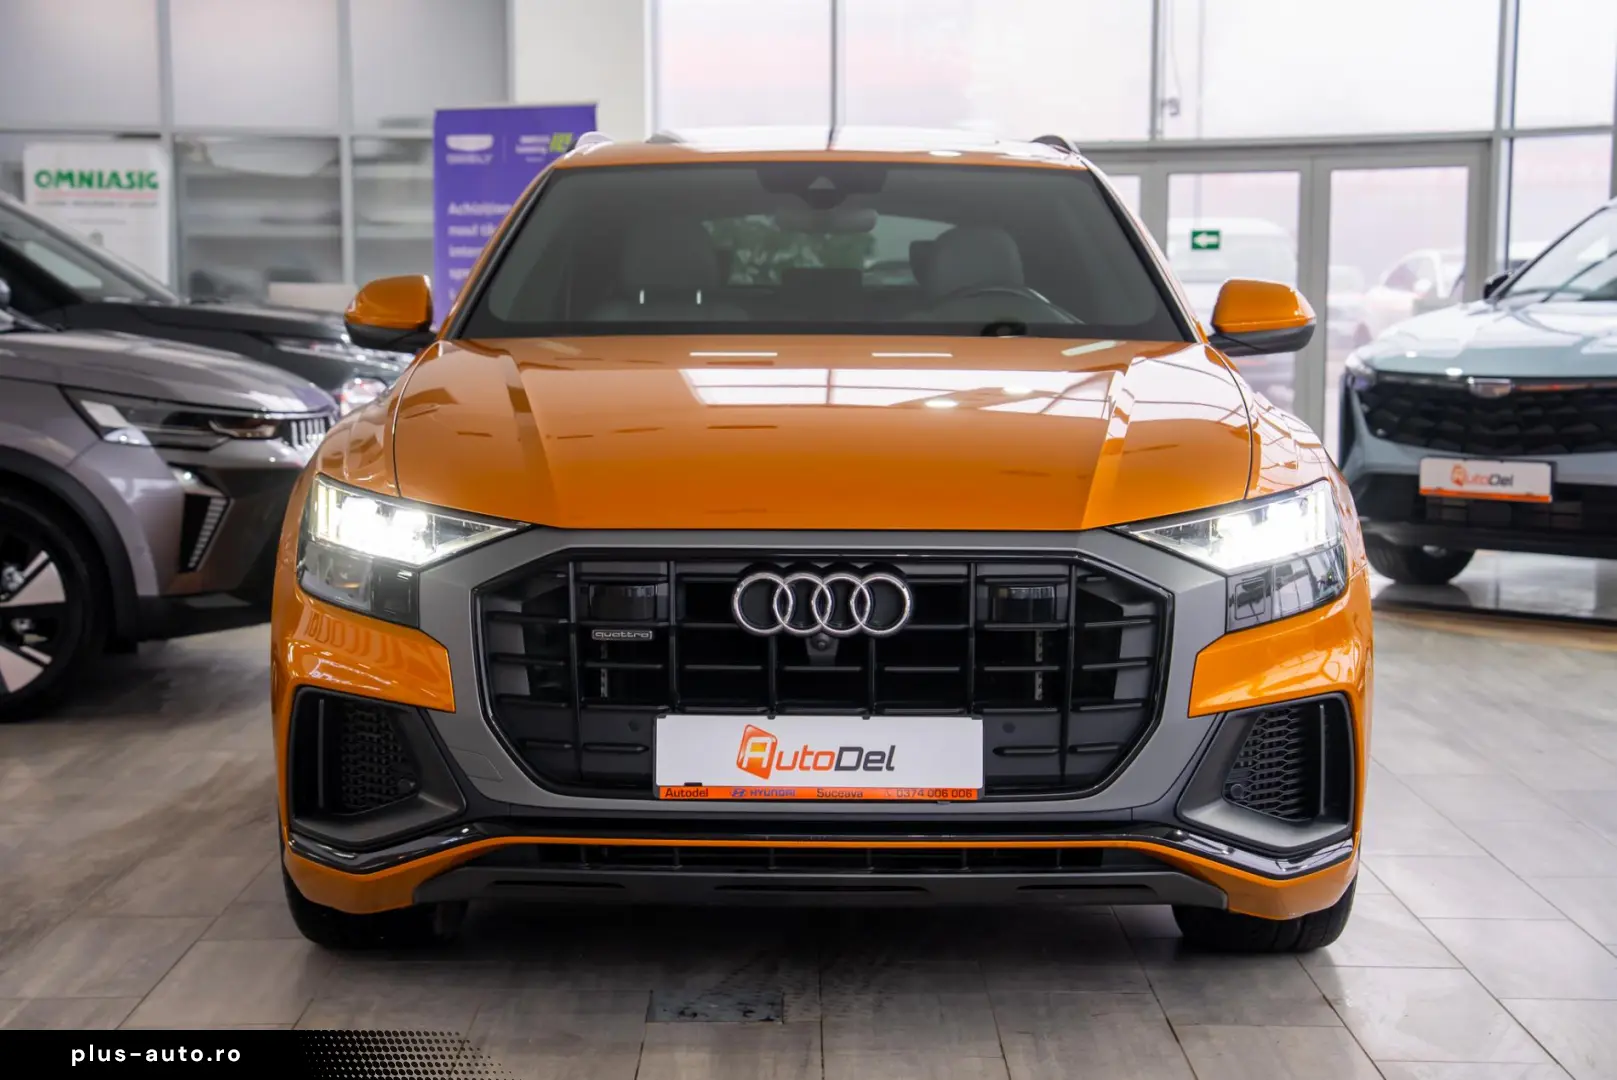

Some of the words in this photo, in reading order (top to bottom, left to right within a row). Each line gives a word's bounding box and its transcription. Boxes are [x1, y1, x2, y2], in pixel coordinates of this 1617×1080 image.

[34, 168, 159, 190] OMNIASIG
[737, 724, 896, 780] AutoDel
[665, 788, 709, 798] Autodel
[750, 789, 796, 797] HYUNDAI
[816, 788, 863, 798] Suceava
[896, 788, 925, 798] 0374
[927, 788, 949, 798] 006
[951, 788, 973, 798] 006
